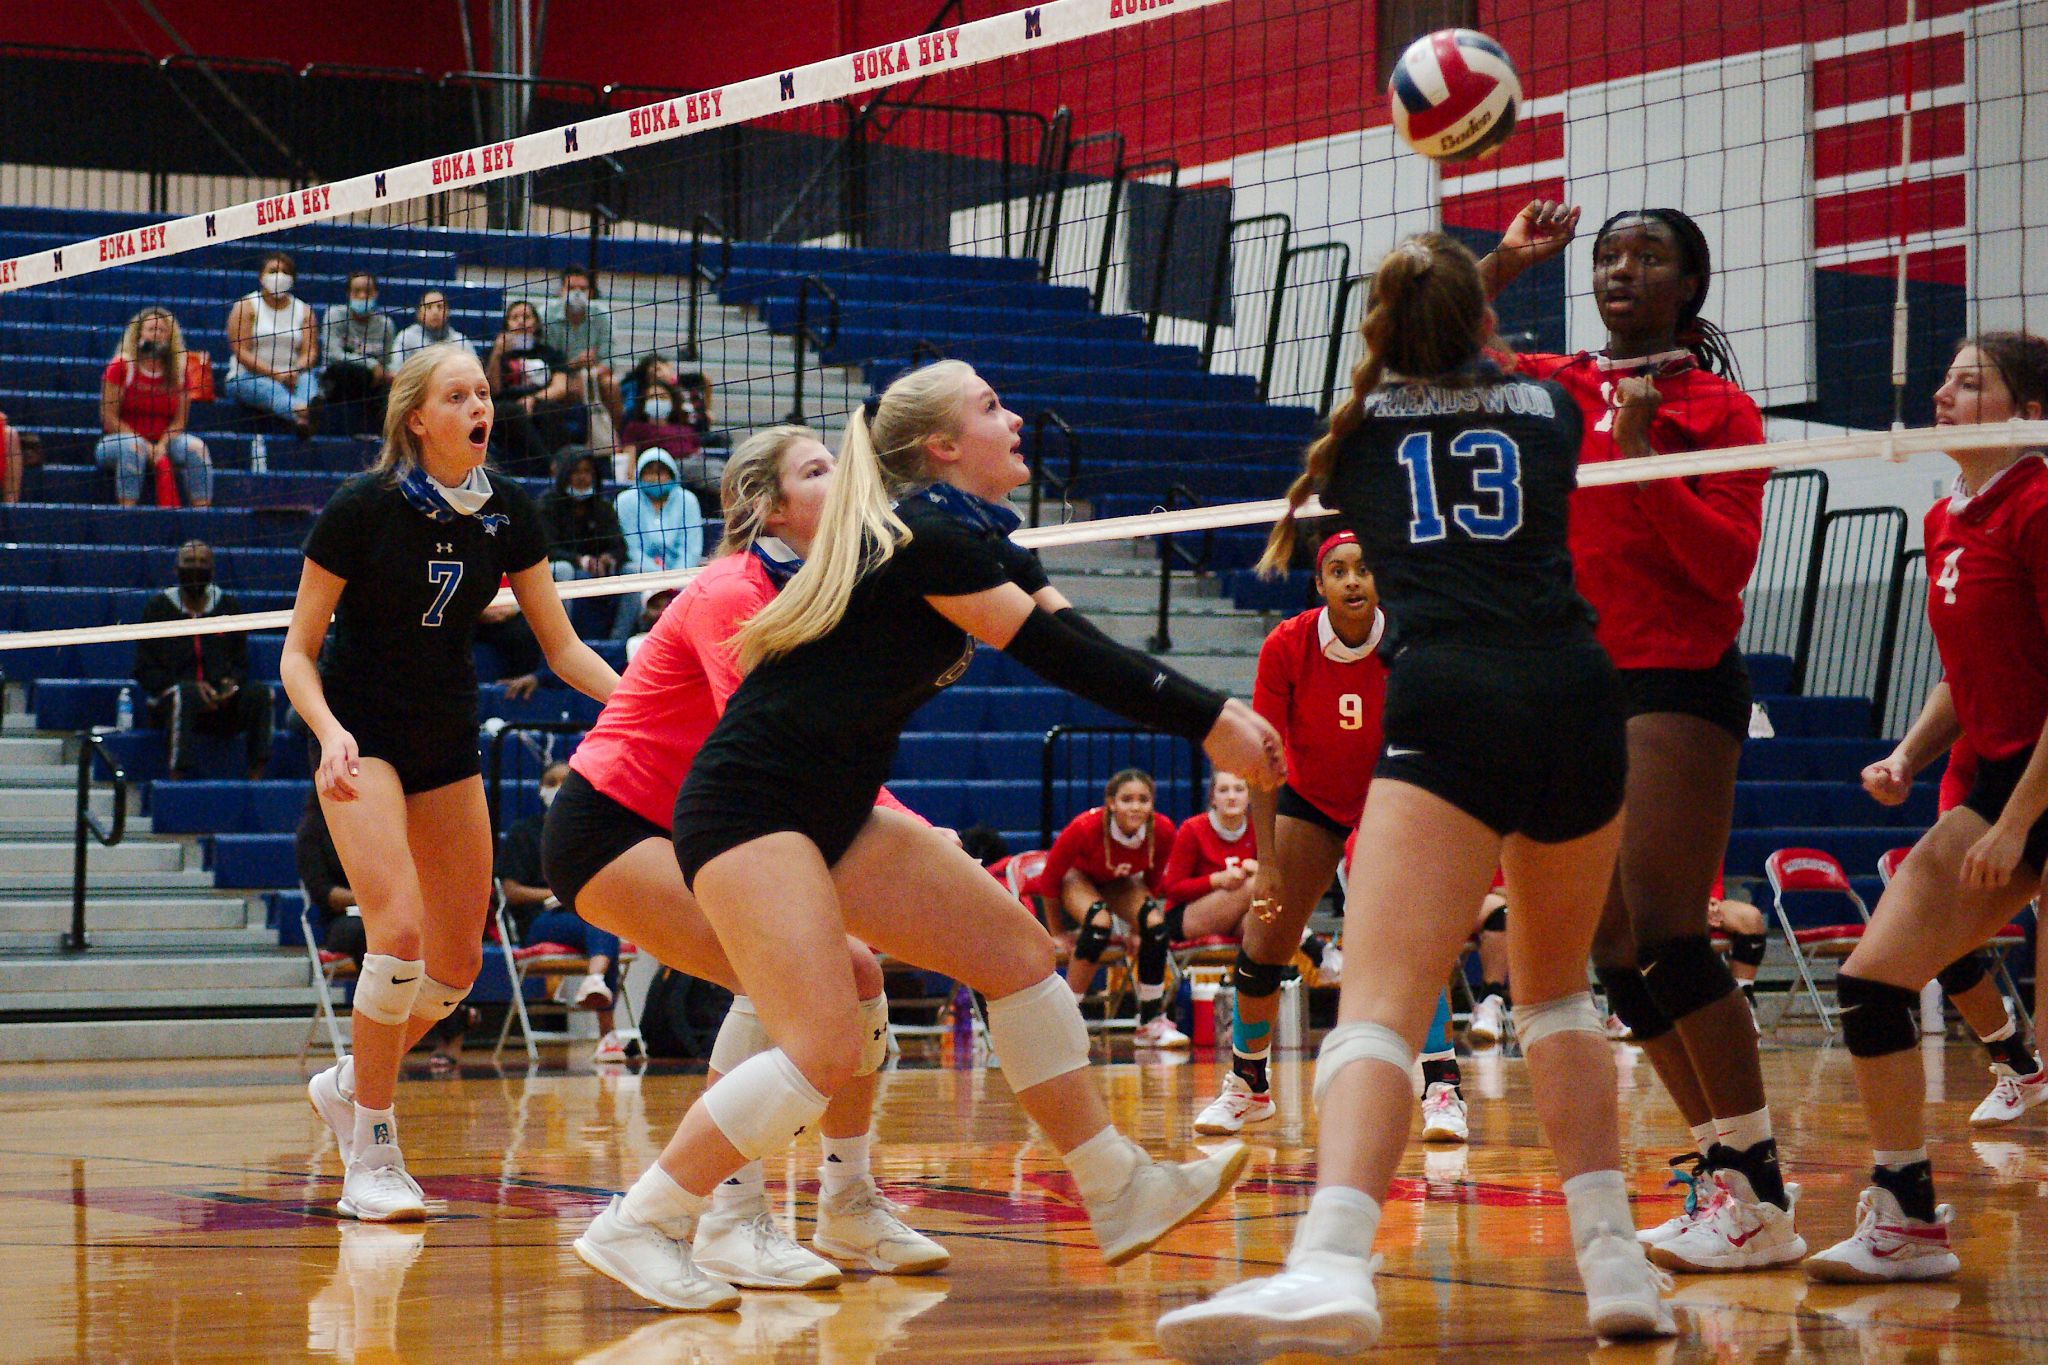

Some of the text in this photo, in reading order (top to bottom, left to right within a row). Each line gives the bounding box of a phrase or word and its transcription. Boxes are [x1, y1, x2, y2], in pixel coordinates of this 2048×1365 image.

[0, 0, 1174, 284] EY M HOKA HEY M HOKA HEY M HOKA HEY M HOKA HEY M HOKA HEY M HO
[1397, 428, 1524, 544] 13
[421, 560, 464, 626] 7
[1935, 546, 1966, 605] 4
[1338, 693, 1363, 730] 9
